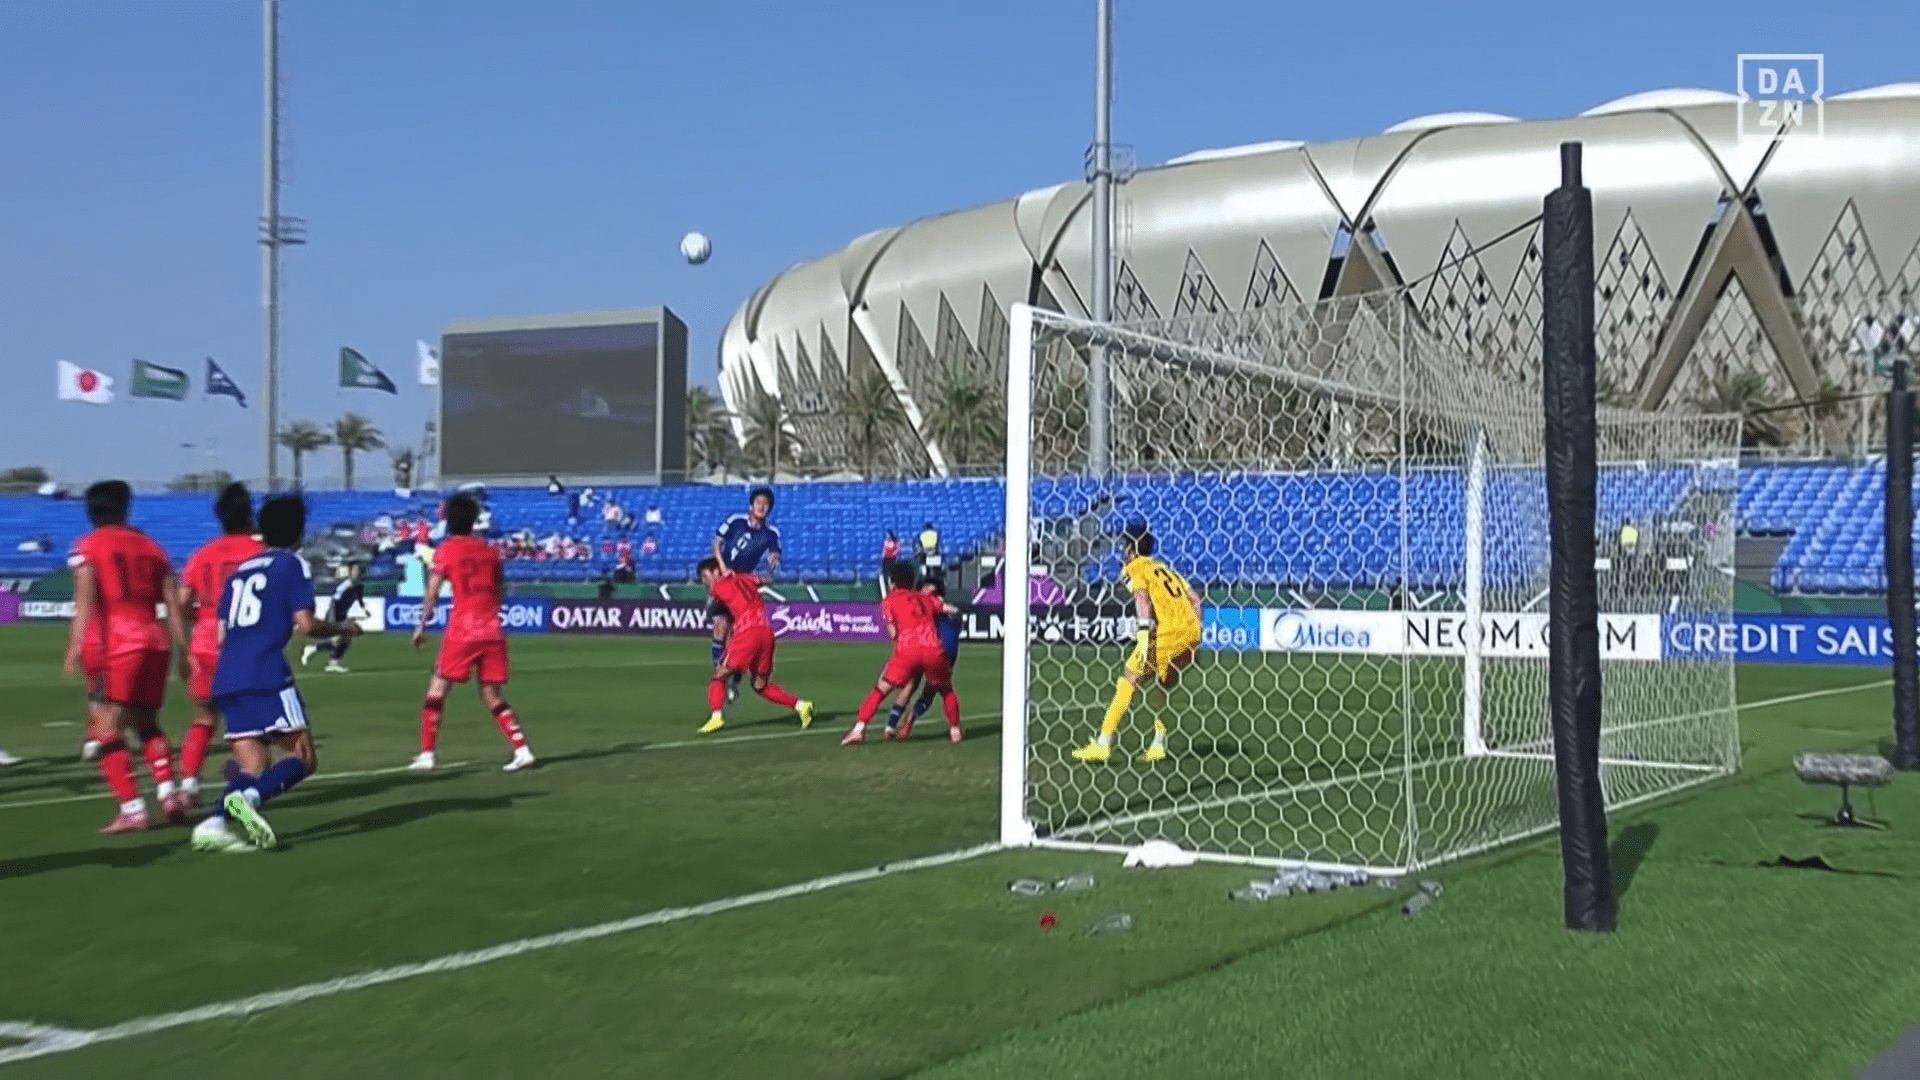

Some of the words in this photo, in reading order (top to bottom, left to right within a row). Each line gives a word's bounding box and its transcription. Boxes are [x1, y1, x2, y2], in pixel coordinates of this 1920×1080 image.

[228, 572, 267, 629] 16
[552, 606, 622, 629] QATAR
[629, 607, 713, 629] AIRWAY
[772, 606, 833, 637] Saudi
[1292, 622, 1371, 648] Midea
[1670, 622, 1806, 655] CREDIT
